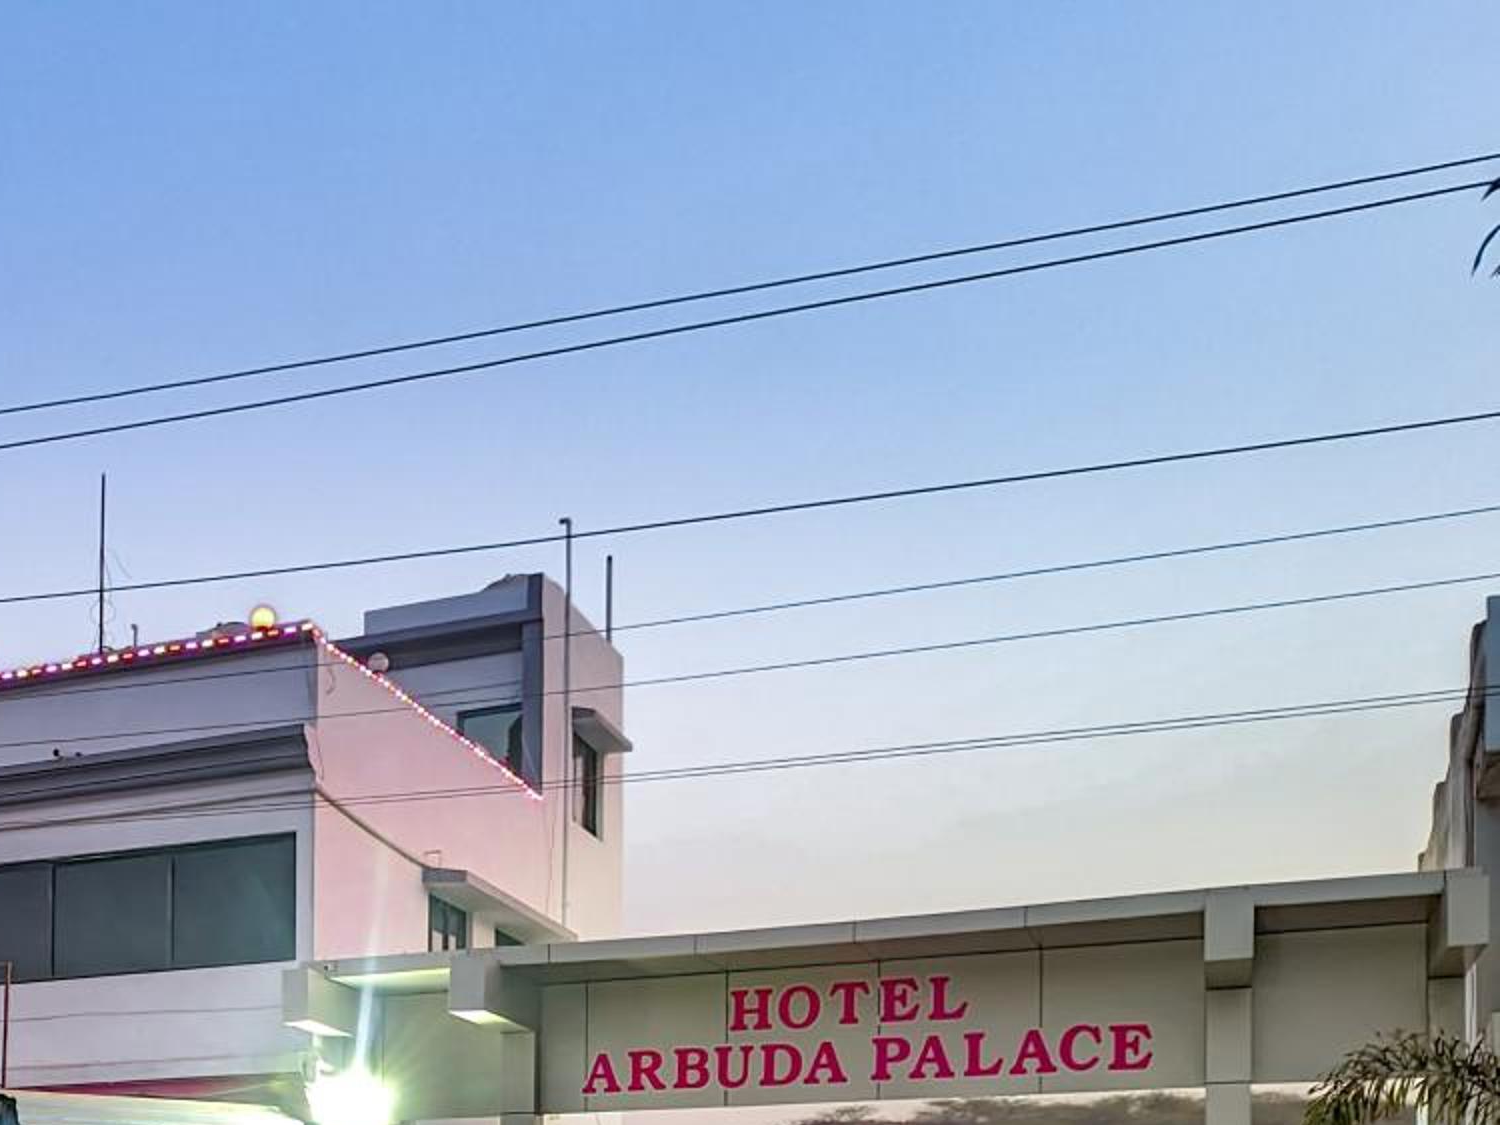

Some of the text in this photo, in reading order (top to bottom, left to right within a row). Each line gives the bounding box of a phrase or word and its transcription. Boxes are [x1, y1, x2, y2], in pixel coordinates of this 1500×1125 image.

[729, 976, 969, 1031] HOTEL
[582, 1024, 1155, 1095] ARBUDA PALACE
